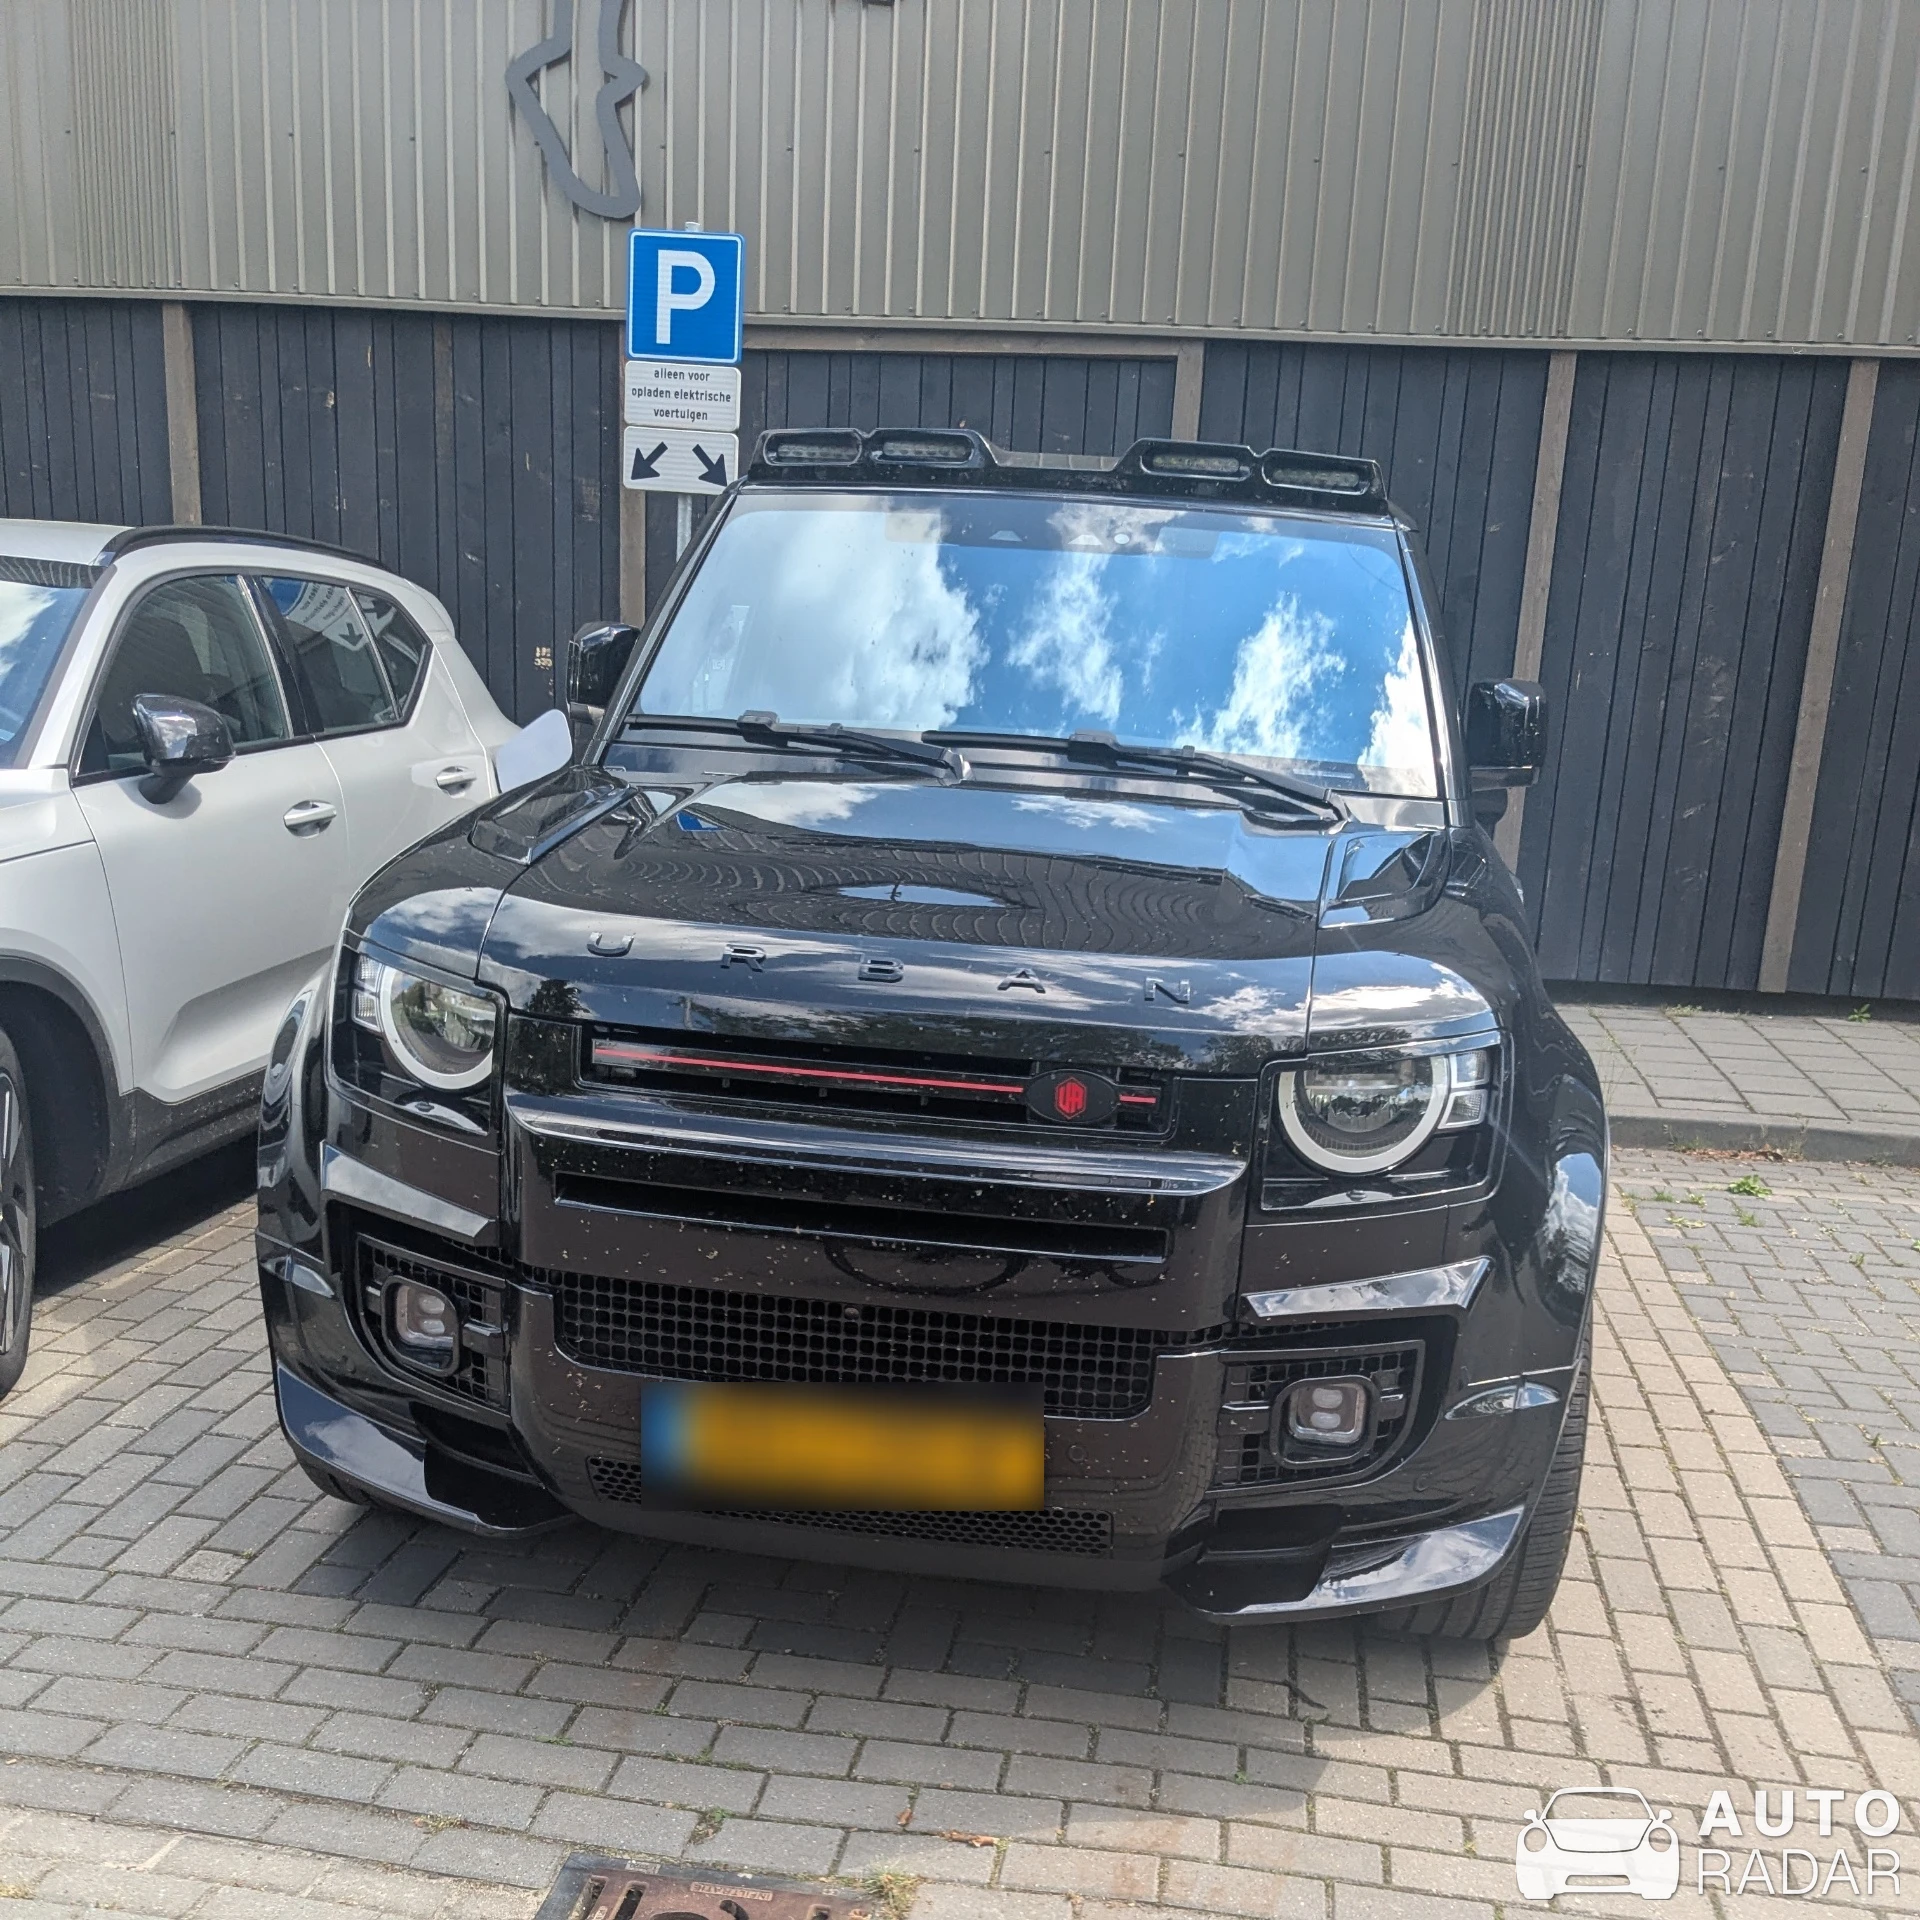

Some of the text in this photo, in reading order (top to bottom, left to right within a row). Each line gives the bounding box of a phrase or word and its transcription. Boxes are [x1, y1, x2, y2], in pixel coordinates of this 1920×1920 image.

[656, 249, 715, 345] P
[654, 367, 710, 382] alleen voor
[631, 386, 731, 403] opladen elektrische
[653, 407, 708, 423] voertuigen
[586, 931, 1192, 1005] URBAN
